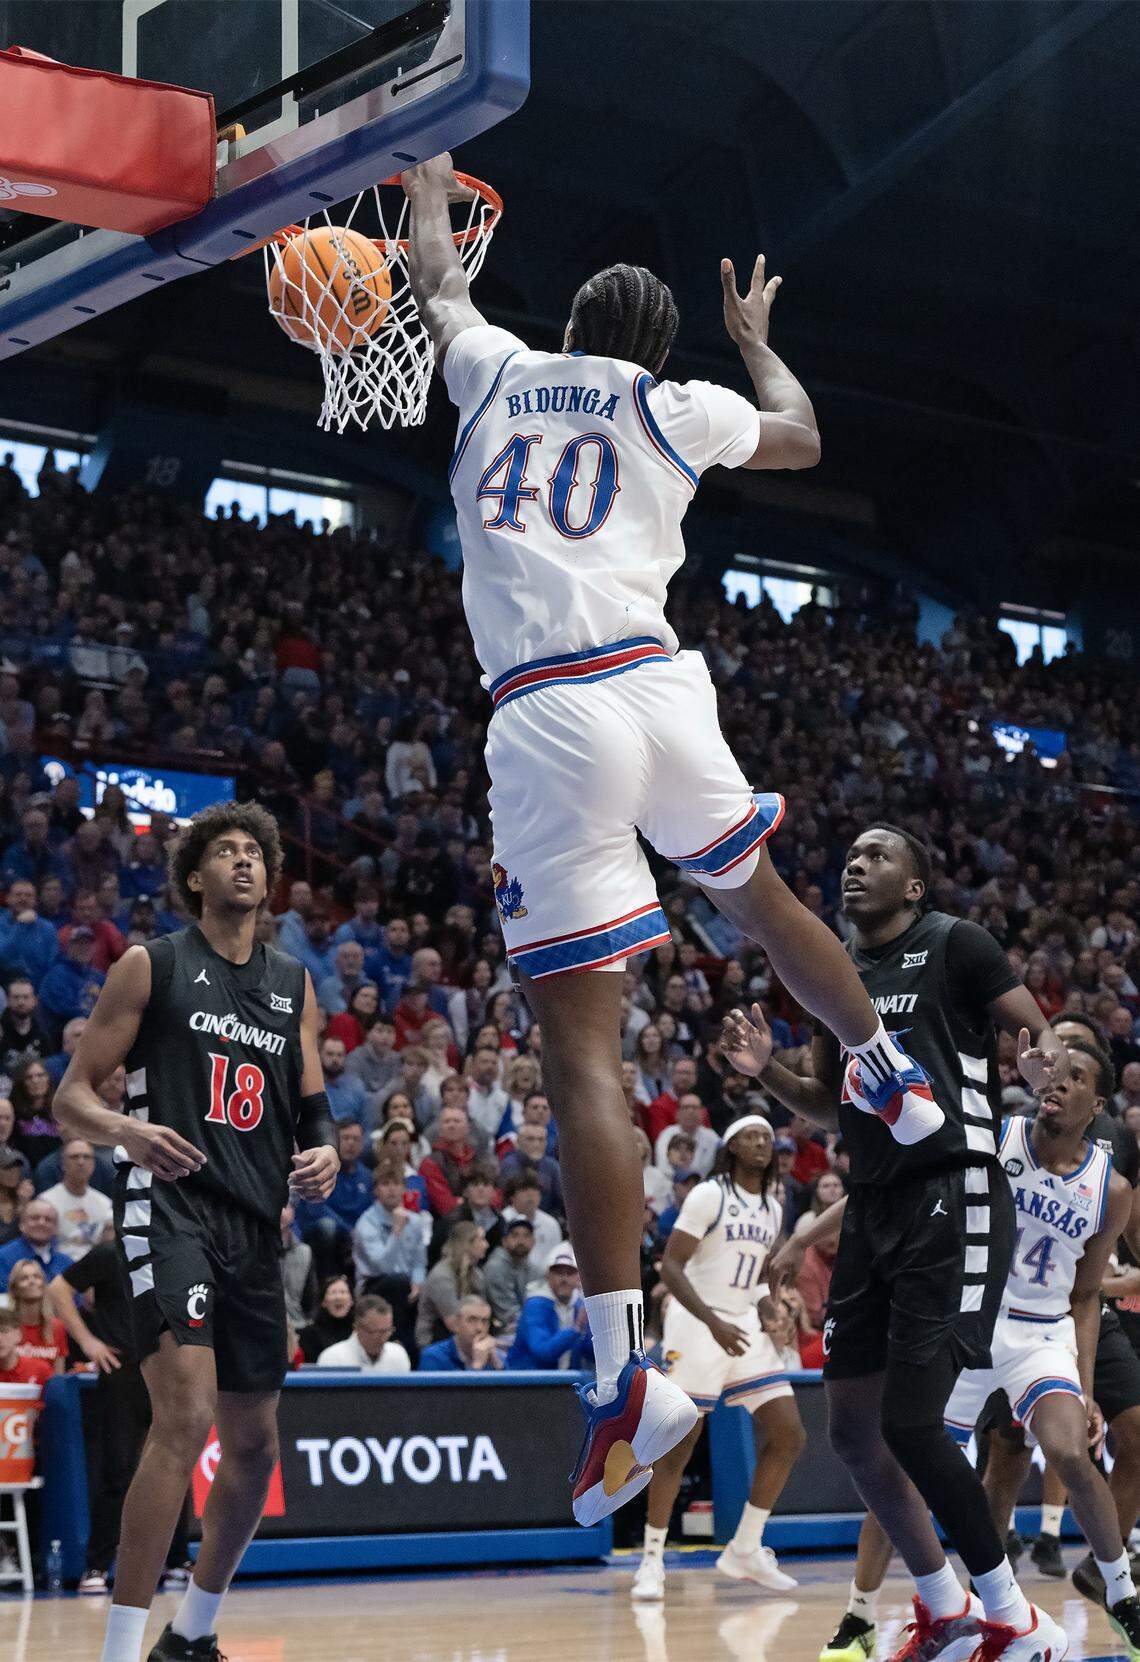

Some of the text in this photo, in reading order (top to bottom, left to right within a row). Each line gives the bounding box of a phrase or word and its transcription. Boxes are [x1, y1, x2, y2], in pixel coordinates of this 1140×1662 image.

[506, 385, 621, 421] BIDUNGA
[476, 432, 622, 540] 40
[189, 1011, 287, 1056] CINCINNATI
[204, 1052, 265, 1132] 18
[1014, 1187, 1088, 1239] ANSAS
[729, 1251, 757, 1290] 11
[4, 1413, 29, 1444] G
[296, 1435, 508, 1487] TOYOTA
